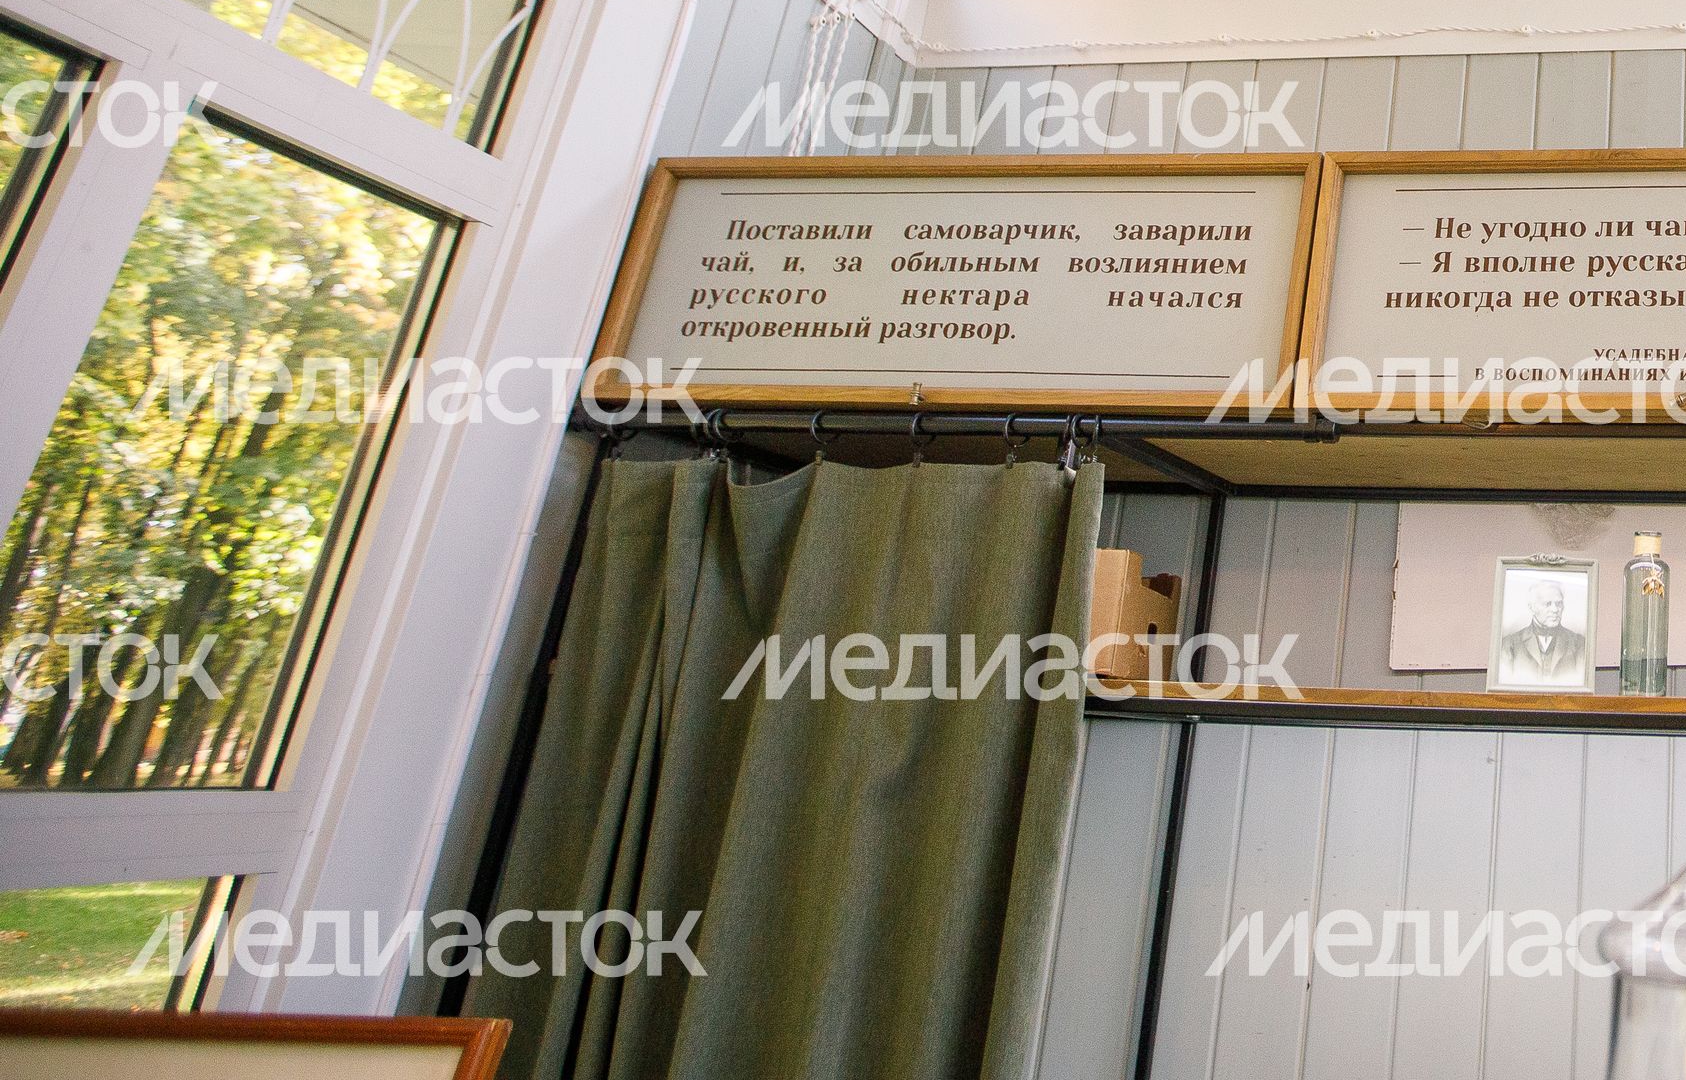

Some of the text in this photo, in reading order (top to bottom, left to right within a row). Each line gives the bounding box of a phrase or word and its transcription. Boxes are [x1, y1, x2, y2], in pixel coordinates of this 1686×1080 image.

[726, 218, 1253, 245] Поставили самоварчик, заварили
[1434, 216, 1472, 239] Не
[1480, 220, 1587, 245] угодно
[1594, 219, 1635, 238] ли
[701, 252, 1248, 275] чай, и, за обильным возлиянием
[1431, 250, 1453, 273] Я
[1463, 254, 1576, 273] вполне
[688, 287, 1244, 310] русского нектара начался
[1383, 288, 1513, 311] никогда
[1522, 289, 1559, 308] не
[680, 315, 1016, 345] откровенный разговор.
[1493, 367, 1672, 382] ВОСПОМИНАНИЯХ
